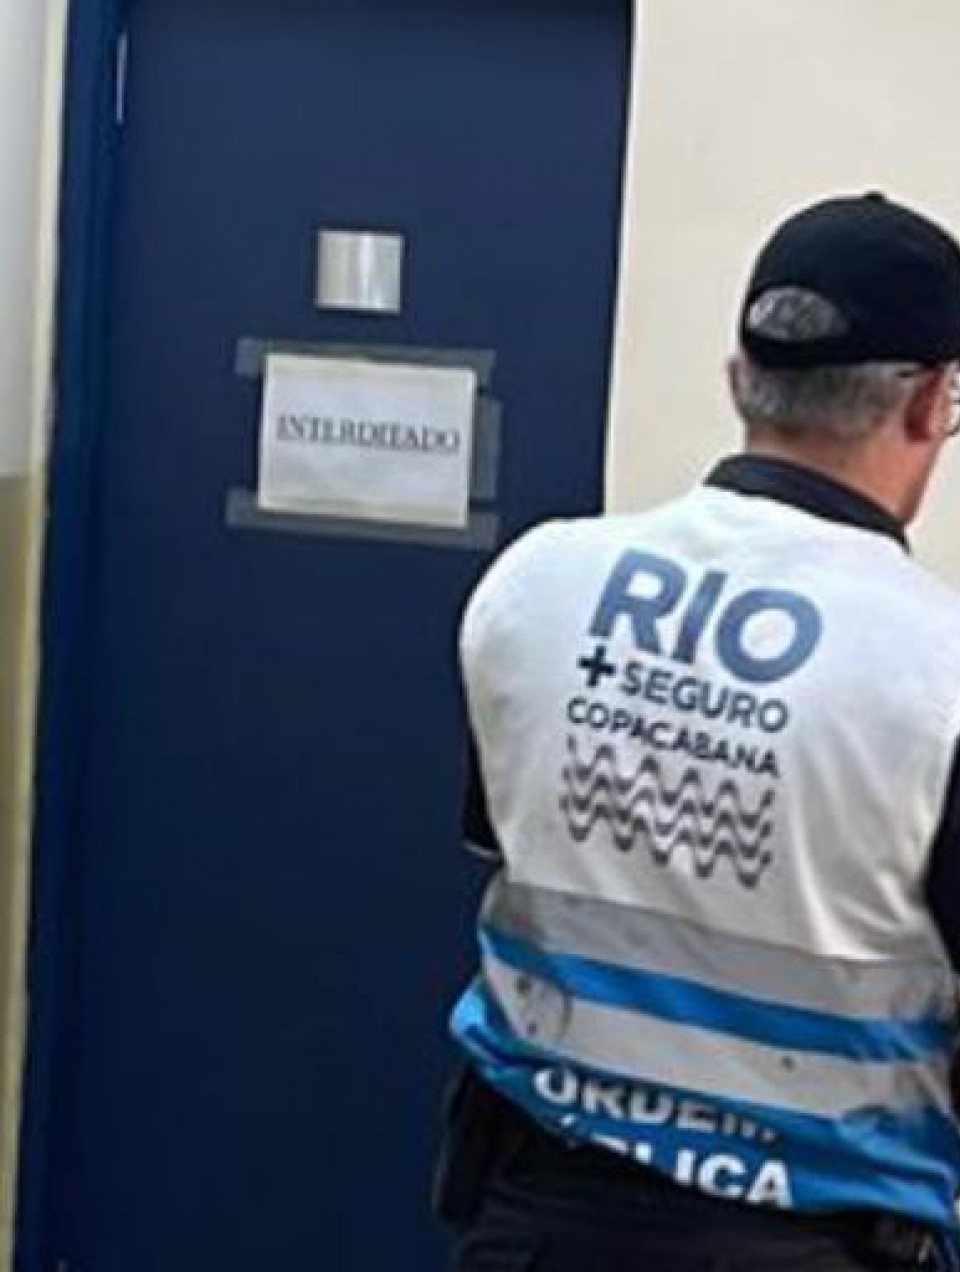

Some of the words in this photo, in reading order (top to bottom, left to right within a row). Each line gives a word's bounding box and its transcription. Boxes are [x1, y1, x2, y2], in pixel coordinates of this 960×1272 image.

[275, 414, 461, 456] INTERDITADO
[588, 548, 823, 684] RIO
[566, 696, 780, 780] COPACABANA
